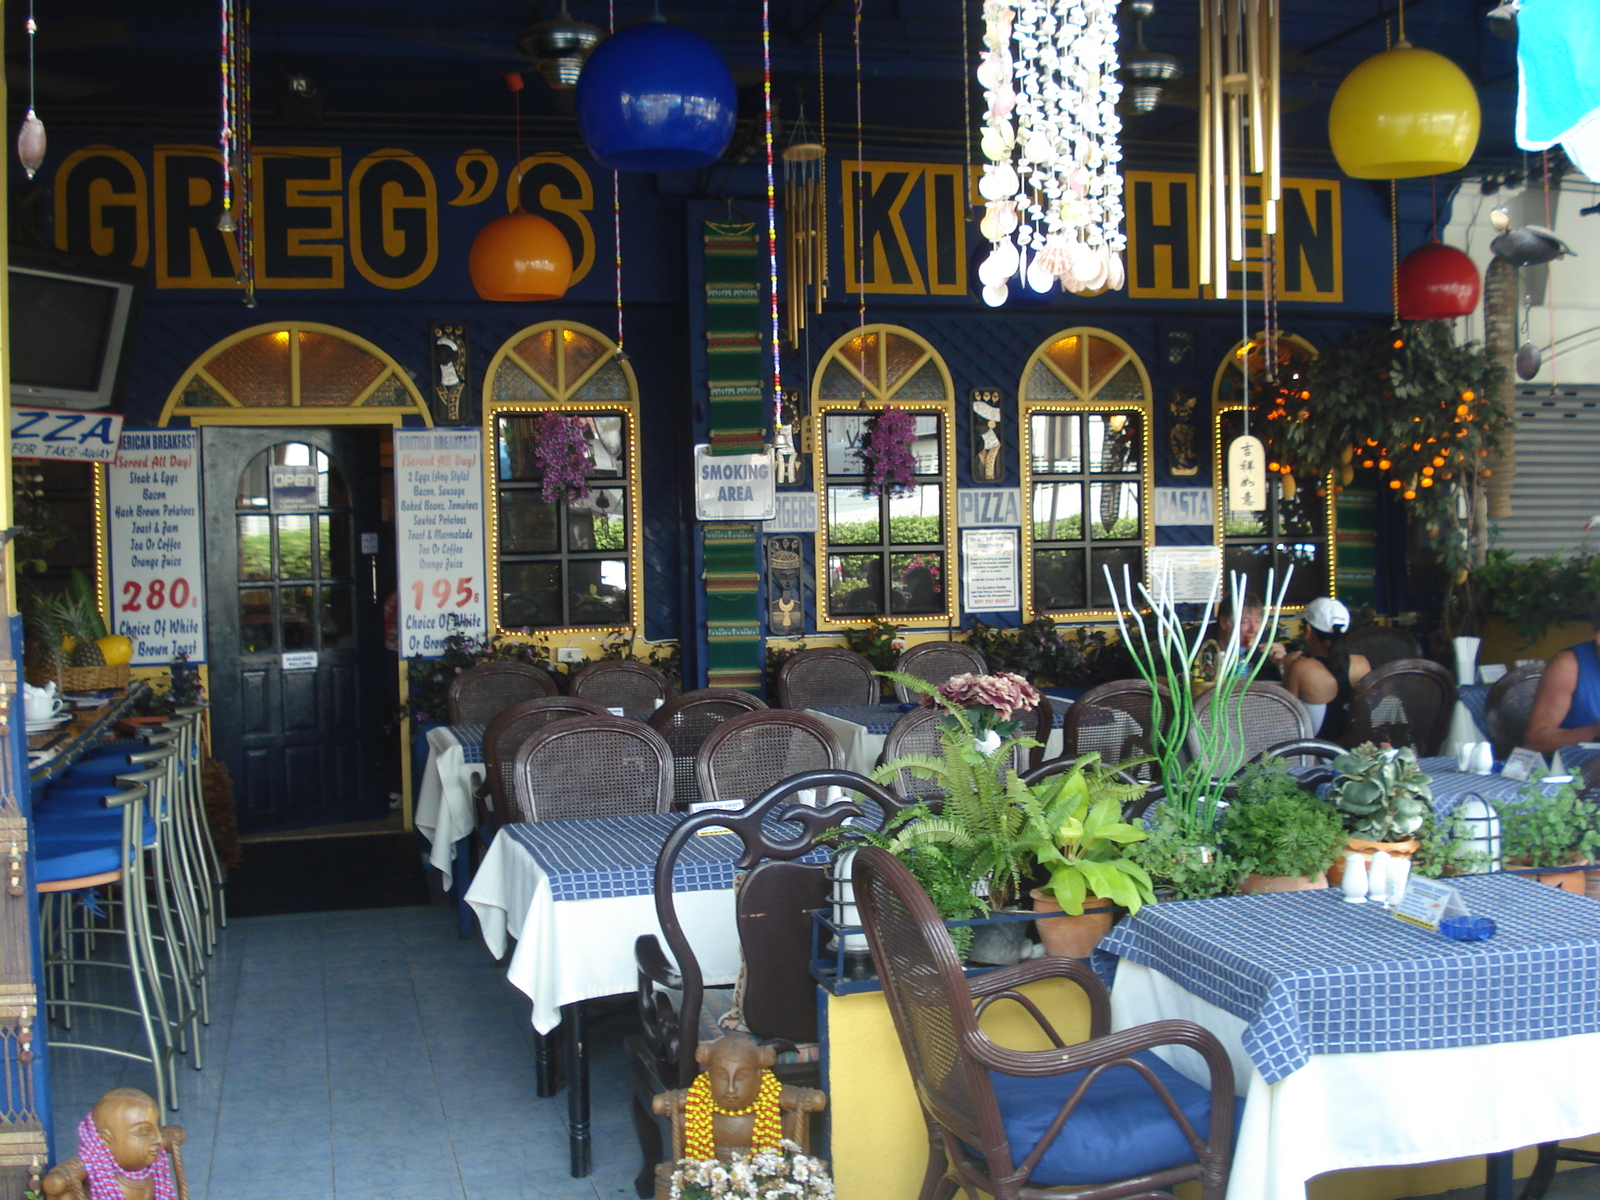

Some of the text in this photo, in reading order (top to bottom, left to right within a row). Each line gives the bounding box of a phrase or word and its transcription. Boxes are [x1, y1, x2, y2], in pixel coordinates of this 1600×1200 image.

[55, 144, 1344, 303] GREG'S KIHEN
[11, 442, 38, 454] FOR
[152, 433, 197, 450] BREAKFAST
[151, 455, 166, 468] All
[170, 453, 193, 470] Day)
[129, 470, 179, 486] Steak & Eggs
[273, 473, 315, 488] OPEN
[407, 471, 413, 483] 2
[414, 470, 431, 485] Eggs
[450, 469, 470, 484] Style)
[702, 464, 769, 481] SMOKING
[142, 488, 166, 501] Bacon
[438, 485, 466, 499] Sausage
[717, 486, 754, 502] AREA
[114, 504, 195, 519] Hash Brown Potatoes
[400, 499, 423, 511] Baked
[448, 499, 479, 511] Tomatoes
[765, 496, 816, 529] RGERS
[960, 491, 1019, 524] PIZZA
[1157, 490, 1211, 523] PASTA
[438, 514, 467, 525] Potatoes
[131, 520, 179, 536] Toast & Jam
[407, 528, 473, 541] Toast & Marmalade
[130, 537, 182, 553] Tea Or Coffee
[431, 543, 441, 555] Or
[441, 543, 464, 556] Coffee
[131, 553, 182, 571] Orange Juice
[419, 557, 464, 572] Orange Juice
[119, 618, 199, 639] Choice Of White
[405, 614, 436, 630] Choice
[137, 639, 197, 657] Brown Toast
[408, 634, 420, 651] Or
[422, 634, 449, 650] Brow
